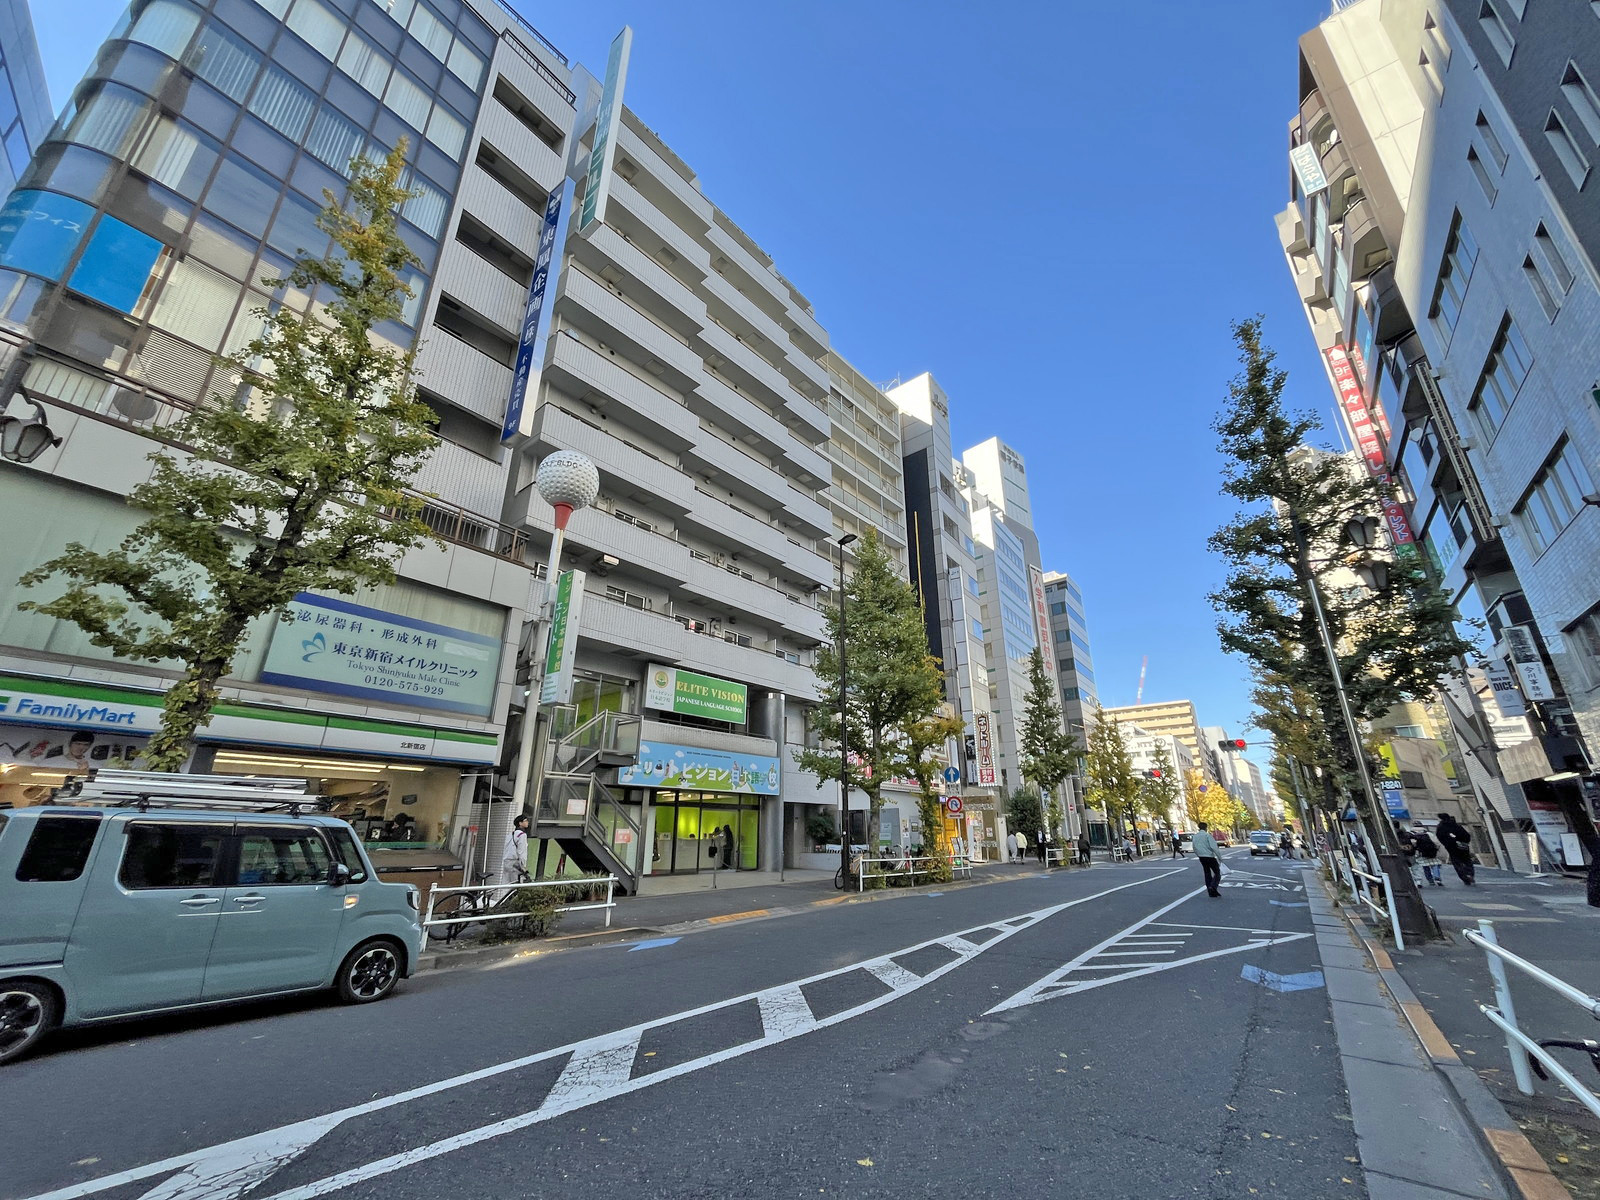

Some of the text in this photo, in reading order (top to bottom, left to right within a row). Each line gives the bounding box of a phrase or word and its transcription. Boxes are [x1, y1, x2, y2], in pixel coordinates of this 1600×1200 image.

[23, 209, 80, 233] フィス
[1334, 365, 1351, 377] 9F
[296, 608, 438, 650] 泌尿器科・形成外科
[551, 602, 562, 645] エリート
[332, 641, 478, 679] 東京新宿メイルクリニック
[347, 660, 461, 688] Tokyo Shinjyuku Male Clinic
[364, 674, 445, 696] 0120-575-929
[1493, 681, 1514, 692] DICE
[675, 680, 745, 704] ELITE VISION
[16, 698, 136, 725] FamilyMart
[676, 696, 701, 706] JAPANESE
[700, 699, 725, 711] LANGUAGE
[725, 704, 743, 714] SCHOOL
[978, 715, 991, 766] ネットルーム
